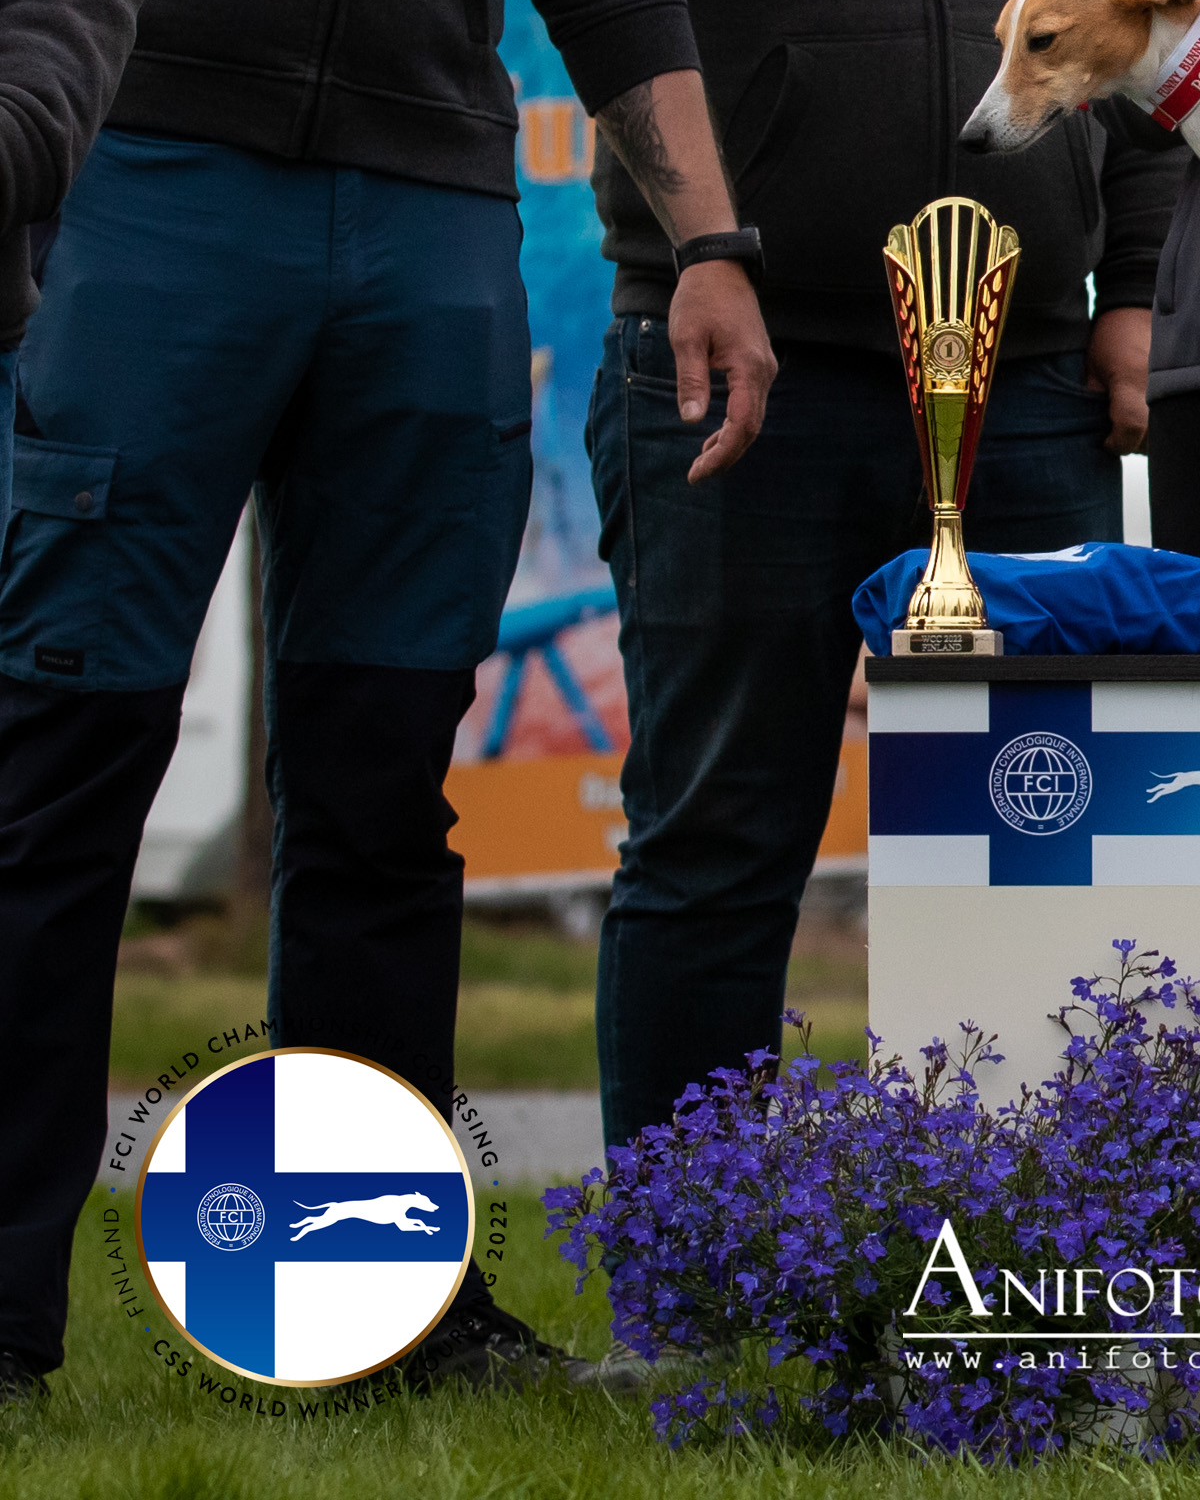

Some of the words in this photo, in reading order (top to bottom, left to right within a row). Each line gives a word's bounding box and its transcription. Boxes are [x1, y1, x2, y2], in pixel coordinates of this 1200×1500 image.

[1155, 70, 1183, 98] FUNNY
[944, 341, 954, 358] 1
[921, 643, 963, 652] FINLAND
[999, 736, 1067, 768] CYNOLOGIQUE
[1056, 747, 1089, 827] INTERNATIONALE
[1024, 774, 1060, 793] FCI
